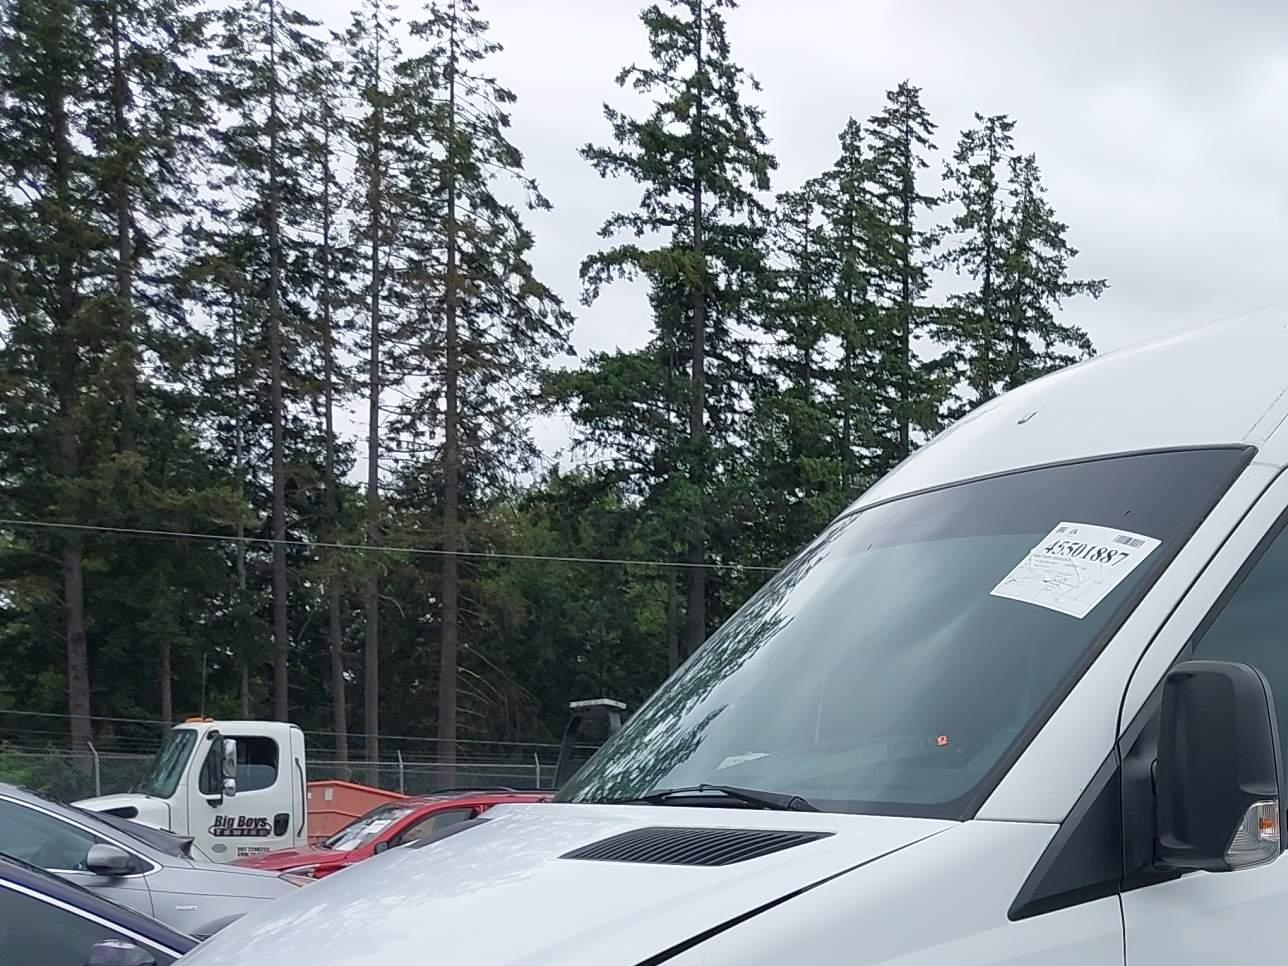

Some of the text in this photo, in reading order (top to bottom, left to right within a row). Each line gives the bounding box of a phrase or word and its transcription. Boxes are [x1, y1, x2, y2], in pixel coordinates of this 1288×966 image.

[1044, 540, 1130, 566] 45501887
[215, 815, 268, 829] Big Boys
